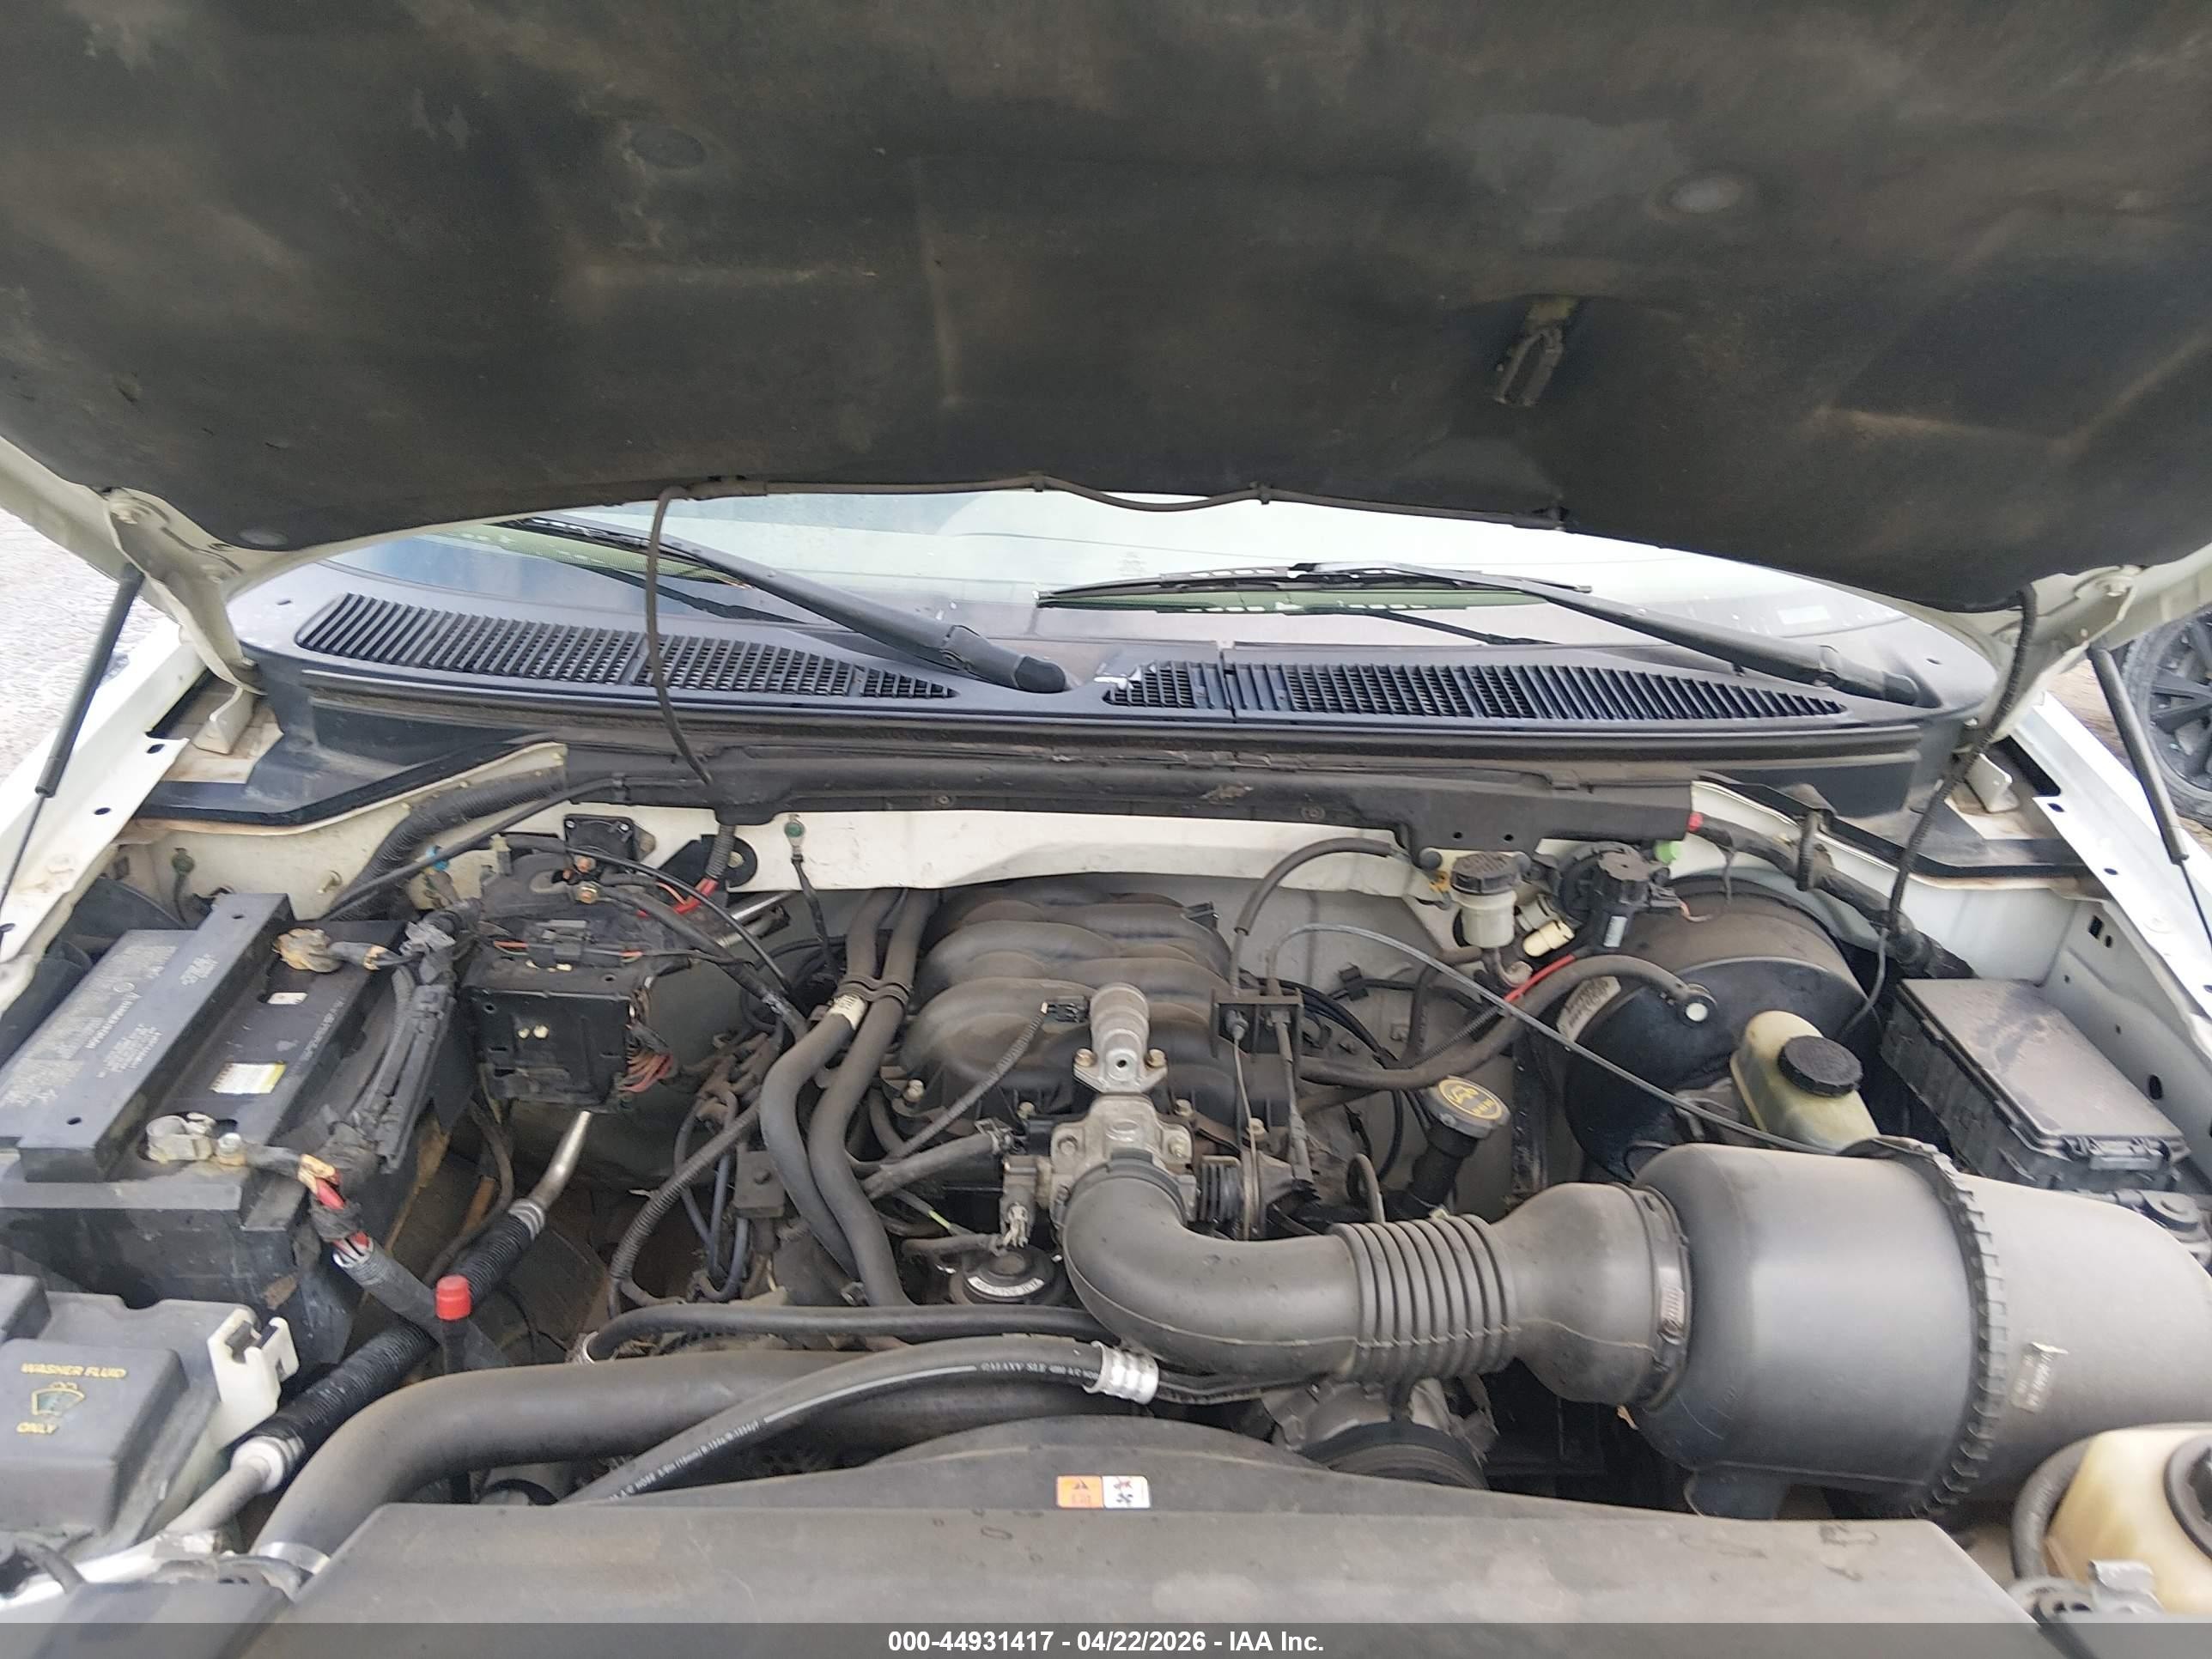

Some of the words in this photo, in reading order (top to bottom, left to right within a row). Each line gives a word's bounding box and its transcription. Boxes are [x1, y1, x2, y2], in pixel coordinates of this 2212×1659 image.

[21, 1363, 84, 1376] WASHER
[84, 1366, 126, 1378] FLUID
[16, 1422, 58, 1434] ONLY
